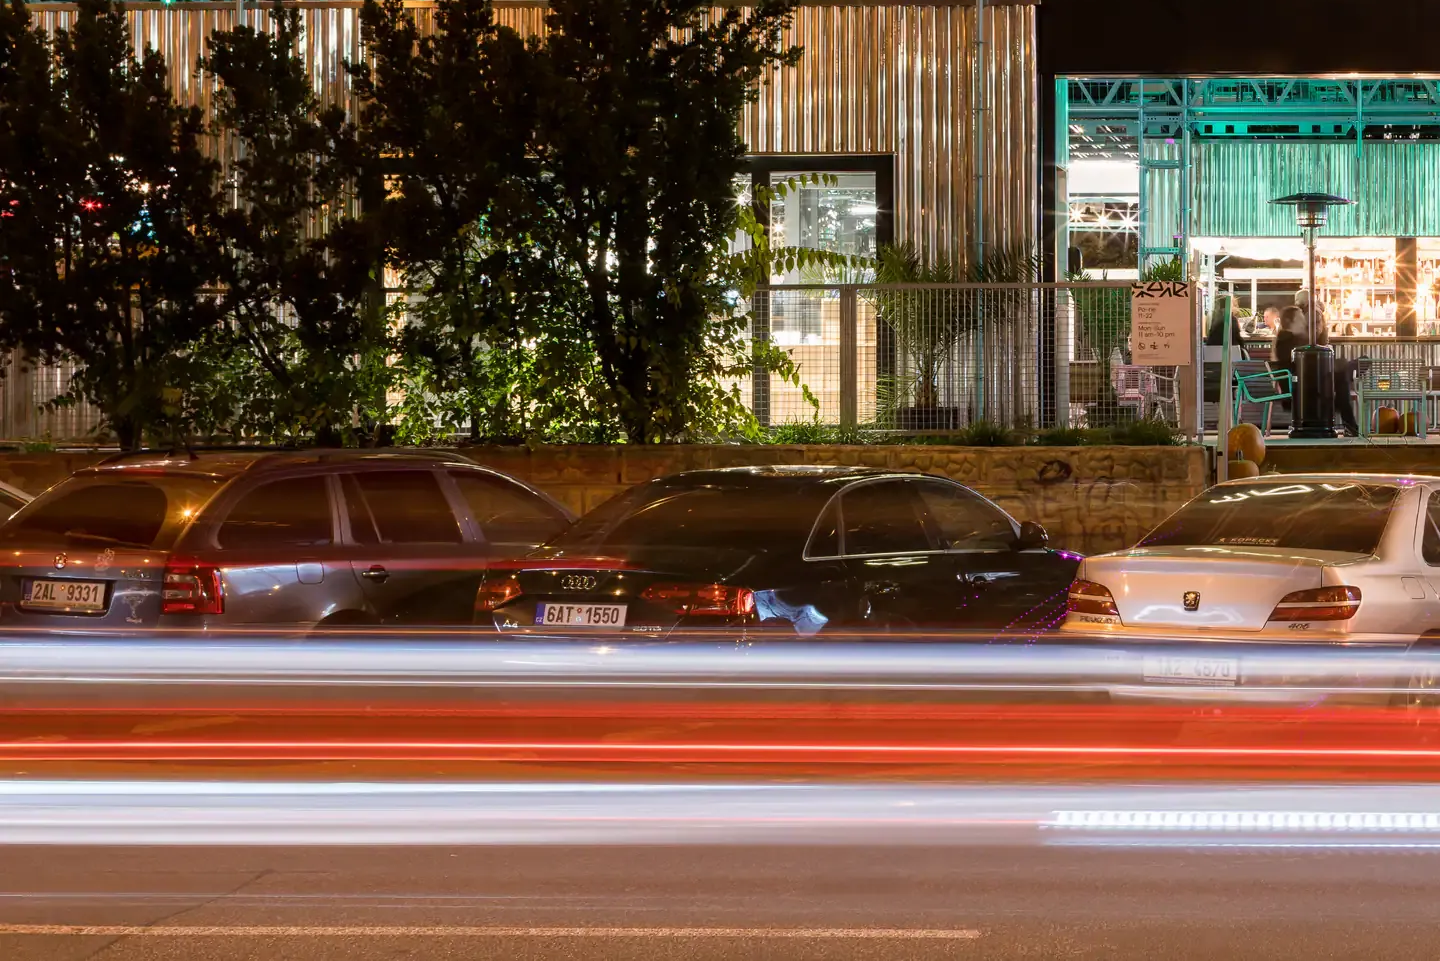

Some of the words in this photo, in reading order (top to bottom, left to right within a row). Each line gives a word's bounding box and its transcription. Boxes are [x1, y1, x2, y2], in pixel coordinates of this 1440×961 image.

[33, 583, 57, 601] 2AL
[66, 583, 99, 603] 9331
[546, 606, 575, 624] 6AT
[585, 607, 620, 624] 1550
